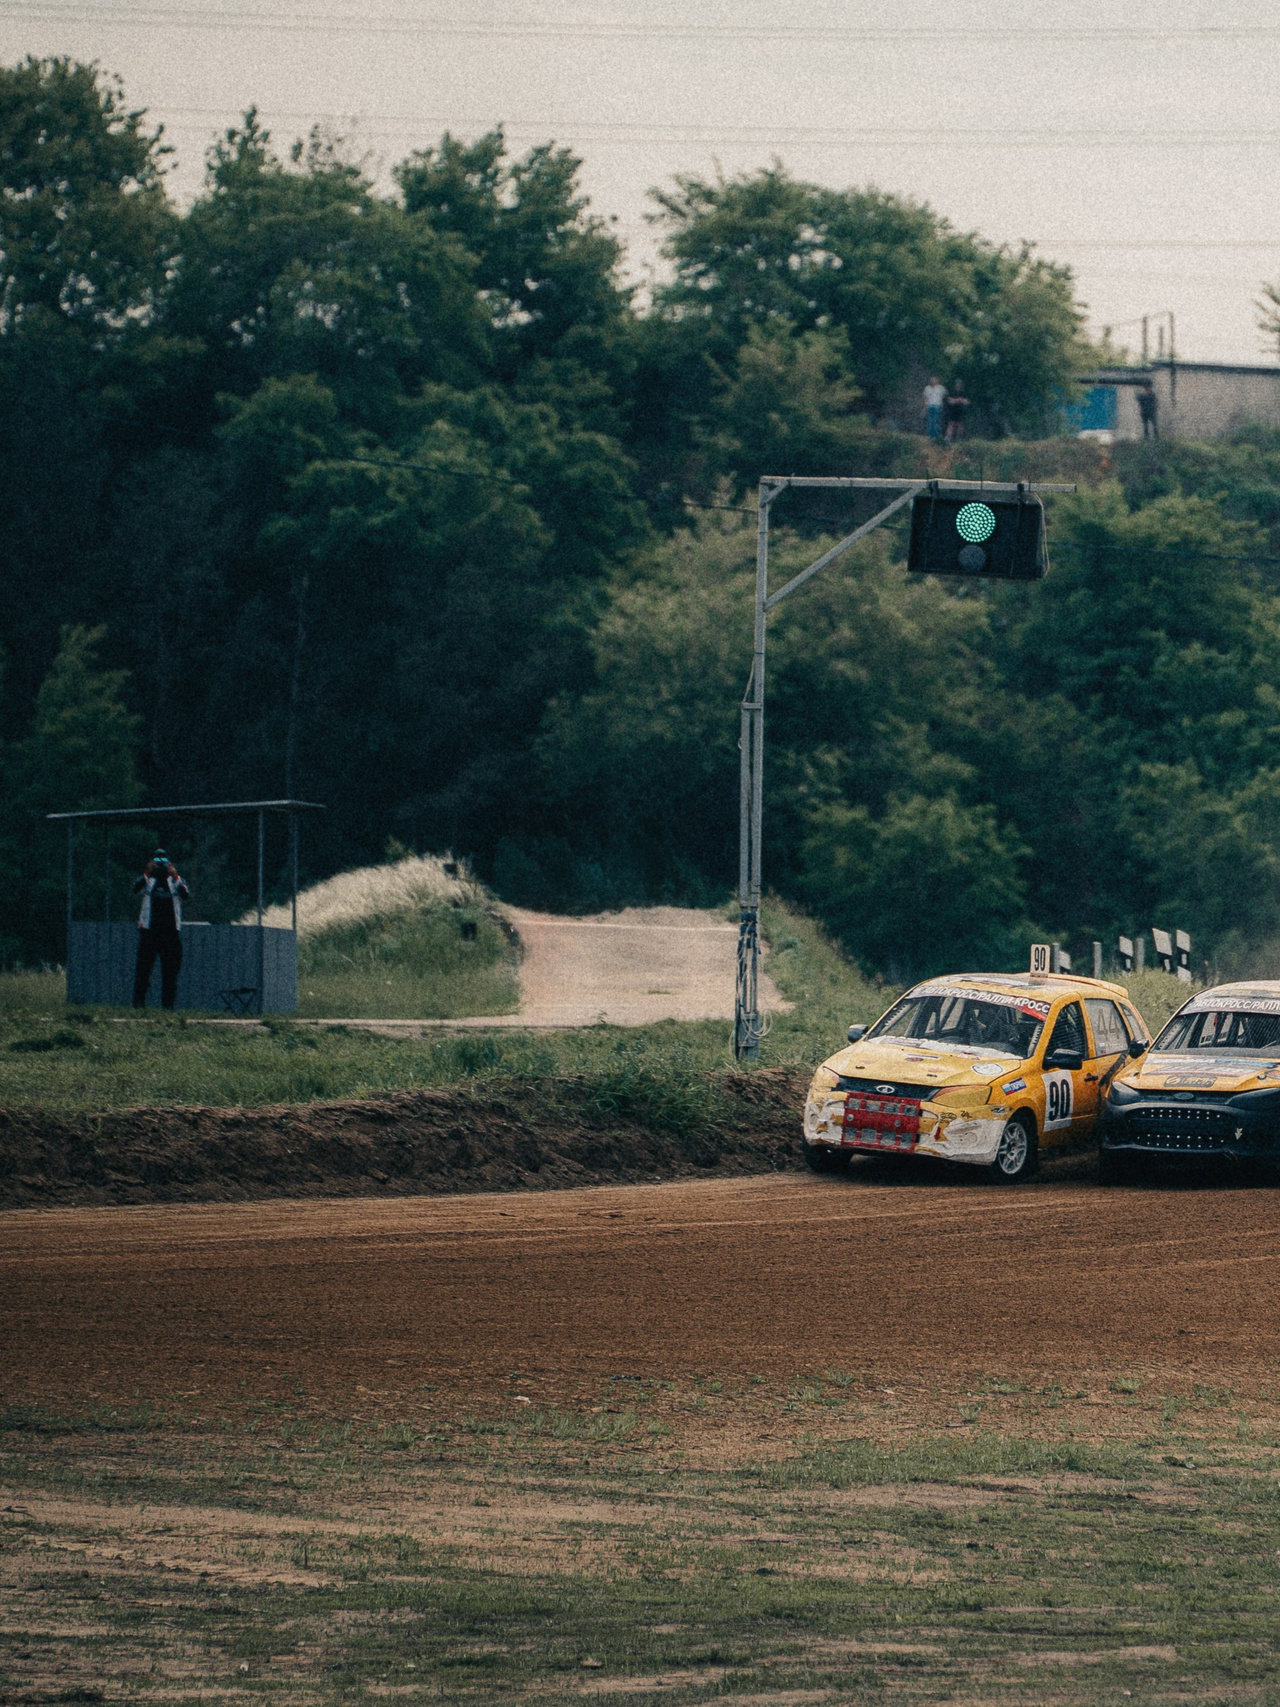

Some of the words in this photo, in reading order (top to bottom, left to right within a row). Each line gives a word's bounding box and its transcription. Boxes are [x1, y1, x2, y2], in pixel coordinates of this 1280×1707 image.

[1034, 946, 1046, 972] 90
[923, 985, 1050, 1014] АВТОКРОСС/РАЛЛИ-КРОСС
[1097, 1008, 1120, 1041] 44
[1048, 1078, 1071, 1121] 90
